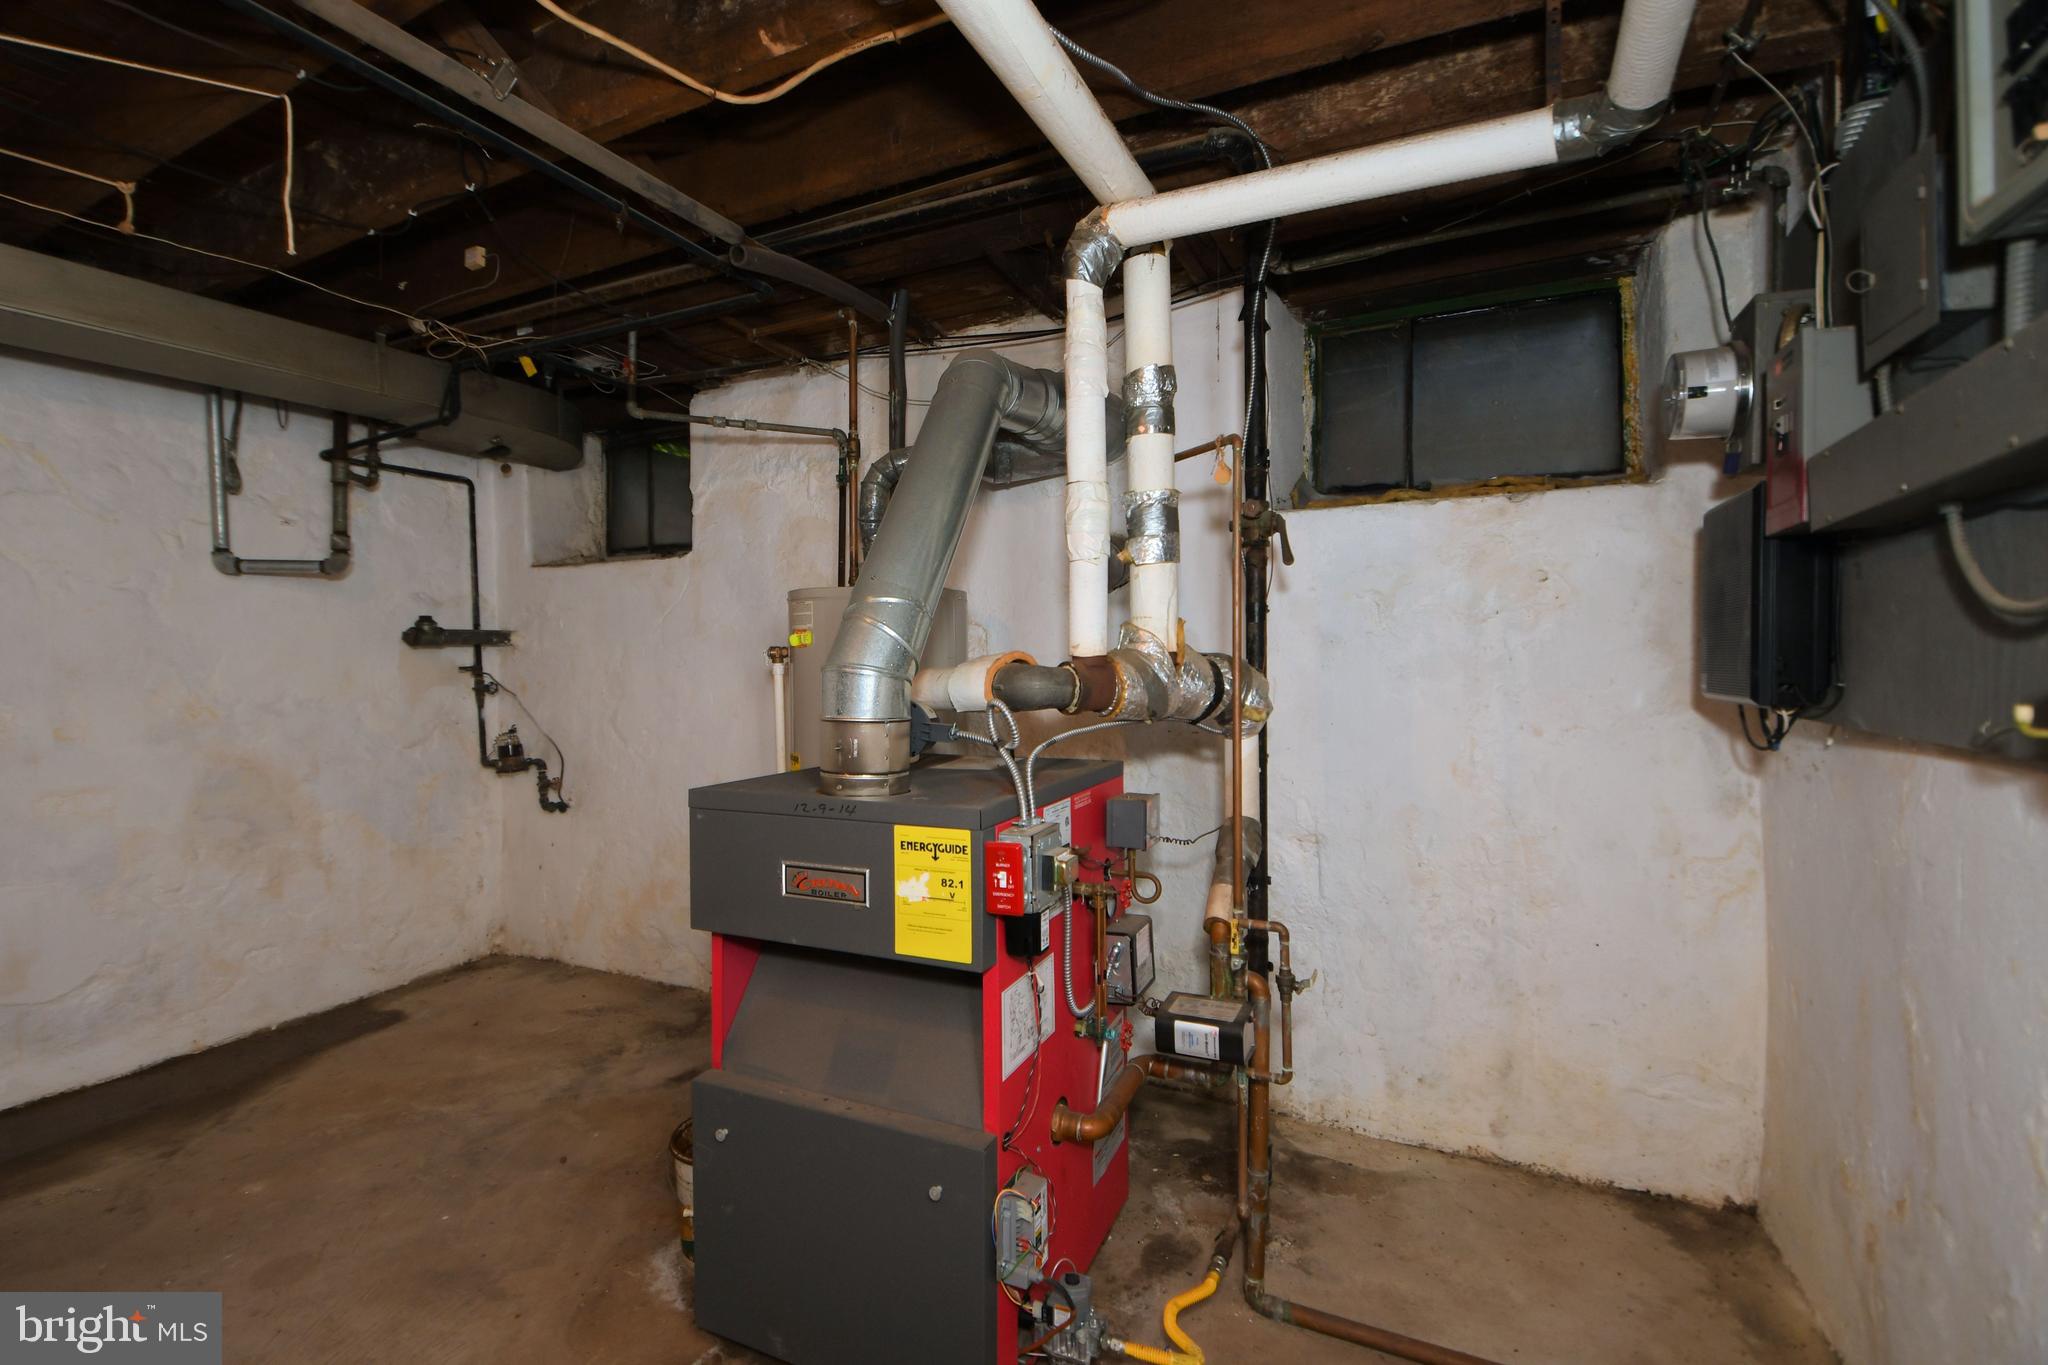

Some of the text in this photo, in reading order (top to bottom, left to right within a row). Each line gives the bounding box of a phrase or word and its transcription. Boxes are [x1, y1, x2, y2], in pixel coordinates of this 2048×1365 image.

[900, 840, 969, 859] ENERGYGUIDE
[941, 878, 964, 889] 82.1
[811, 889, 848, 899] BOILER
